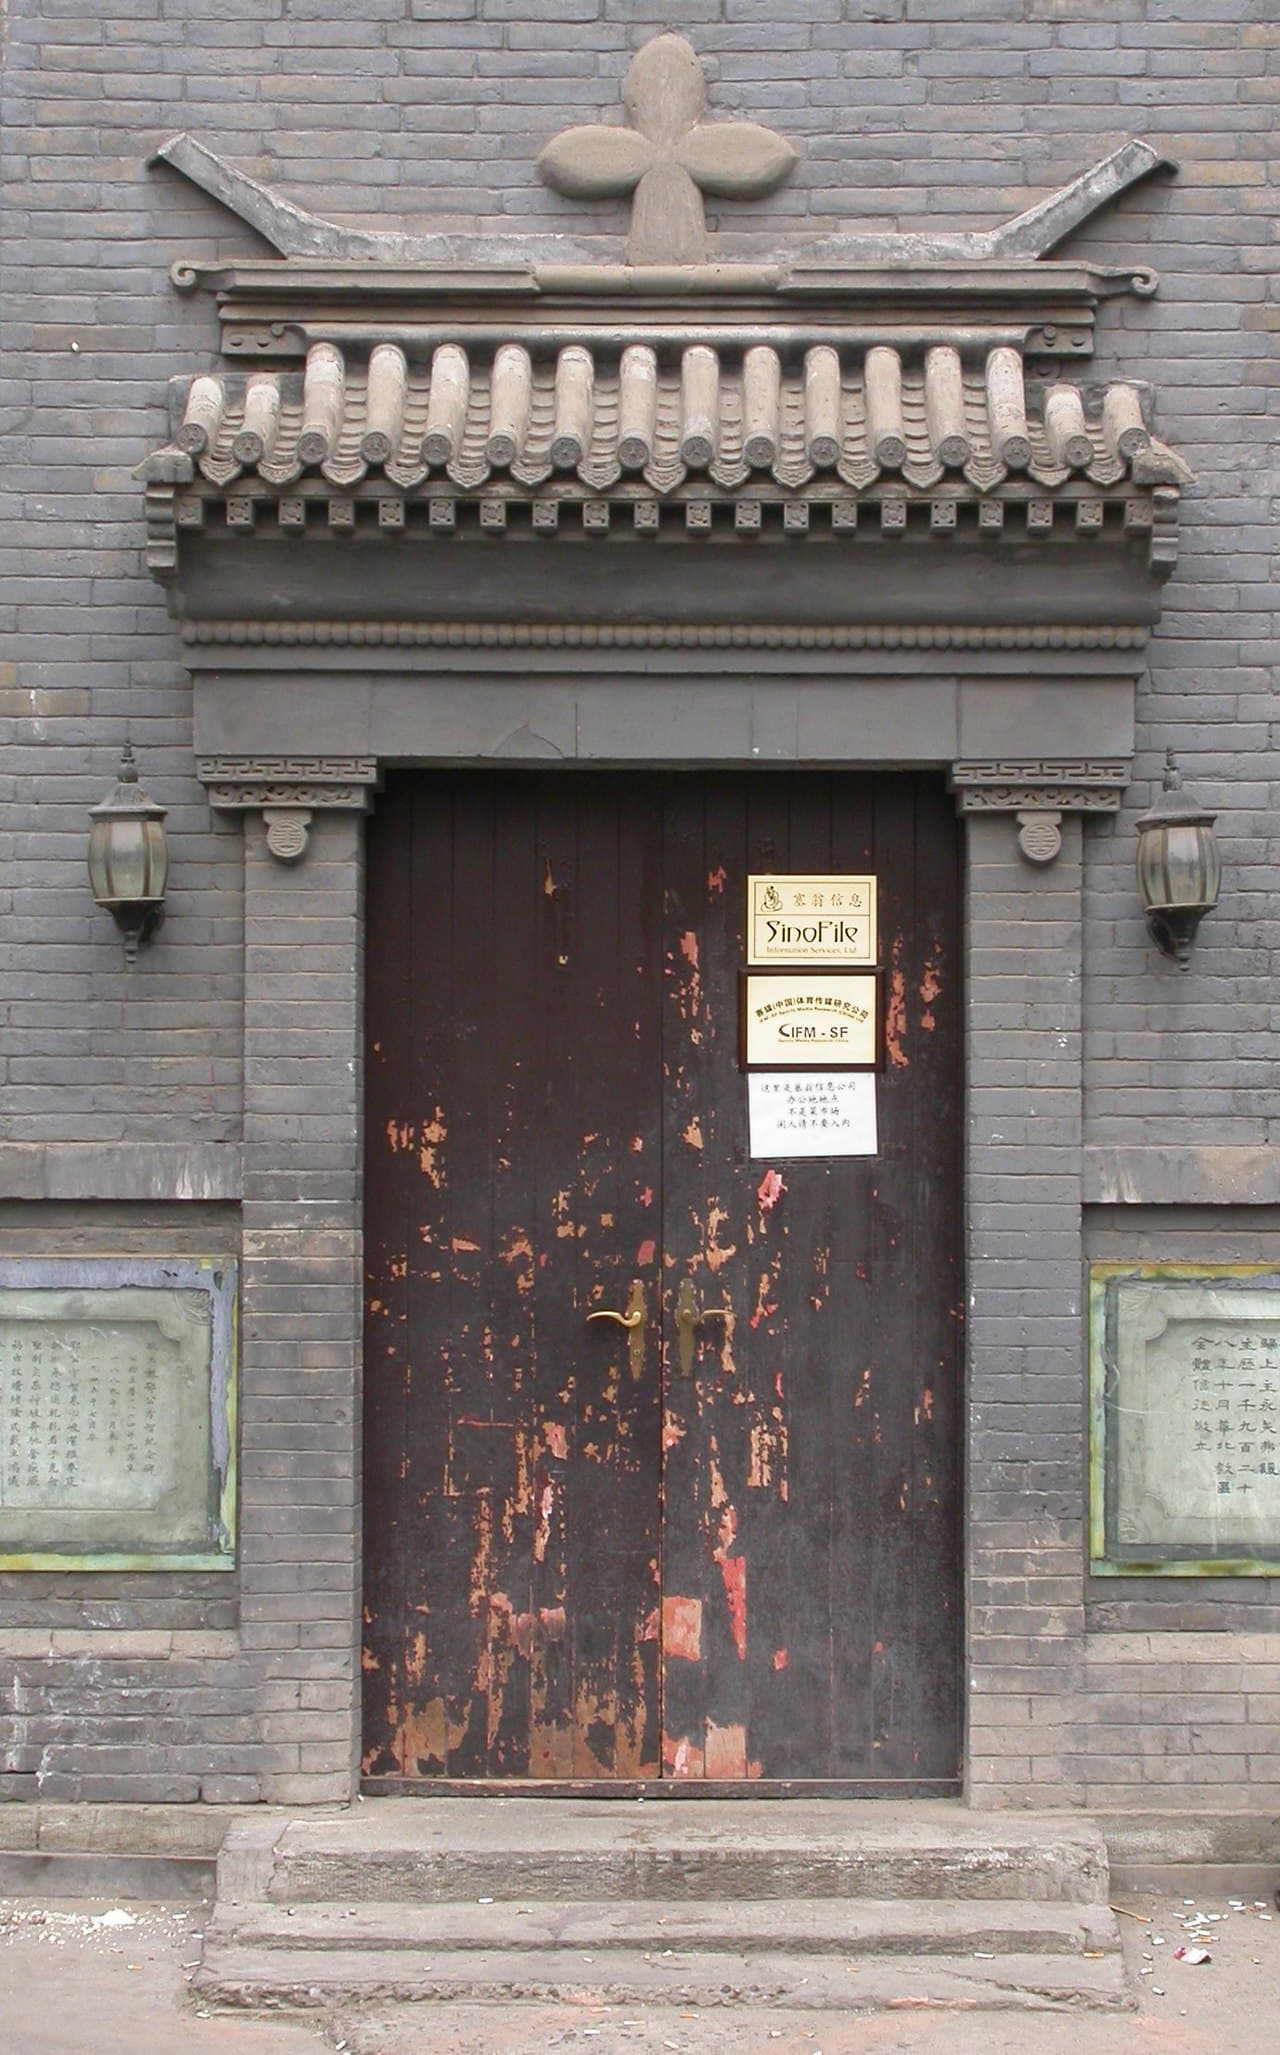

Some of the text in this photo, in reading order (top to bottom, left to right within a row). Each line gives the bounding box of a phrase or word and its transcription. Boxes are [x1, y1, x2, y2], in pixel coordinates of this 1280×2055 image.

[766, 920, 858, 943] SinoFile
[778, 1023, 816, 1038] CIFM
[830, 1026, 849, 1038] SF
